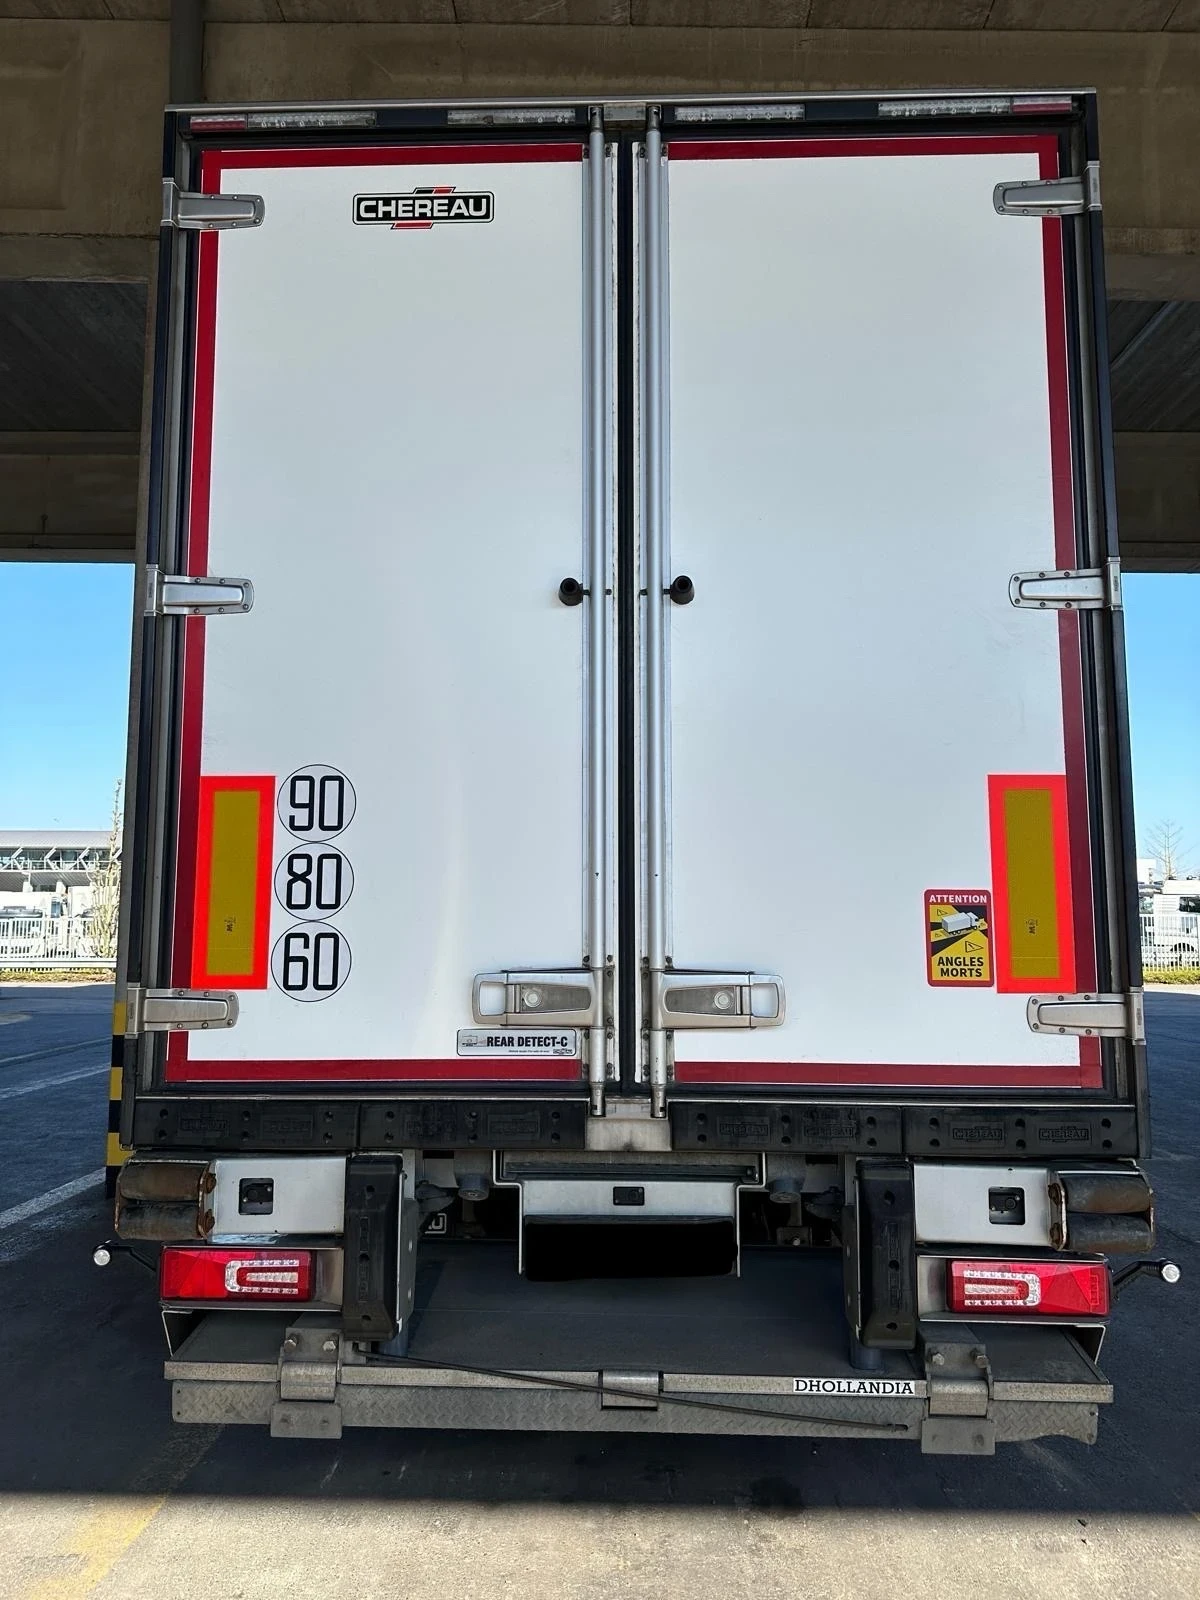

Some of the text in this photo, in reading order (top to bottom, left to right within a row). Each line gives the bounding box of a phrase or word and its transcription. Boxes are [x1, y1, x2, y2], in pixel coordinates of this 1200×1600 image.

[359, 198, 487, 218] CHEREAU
[289, 775, 345, 832] 90
[286, 853, 342, 910] 80
[929, 894, 987, 903] ATTENTION
[282, 932, 340, 991] 60
[937, 956, 984, 967] ANGLES
[940, 967, 982, 978] MORTS
[486, 1036, 568, 1047] REAR DETECT-C
[795, 1379, 914, 1394] DHOLLANDIA
